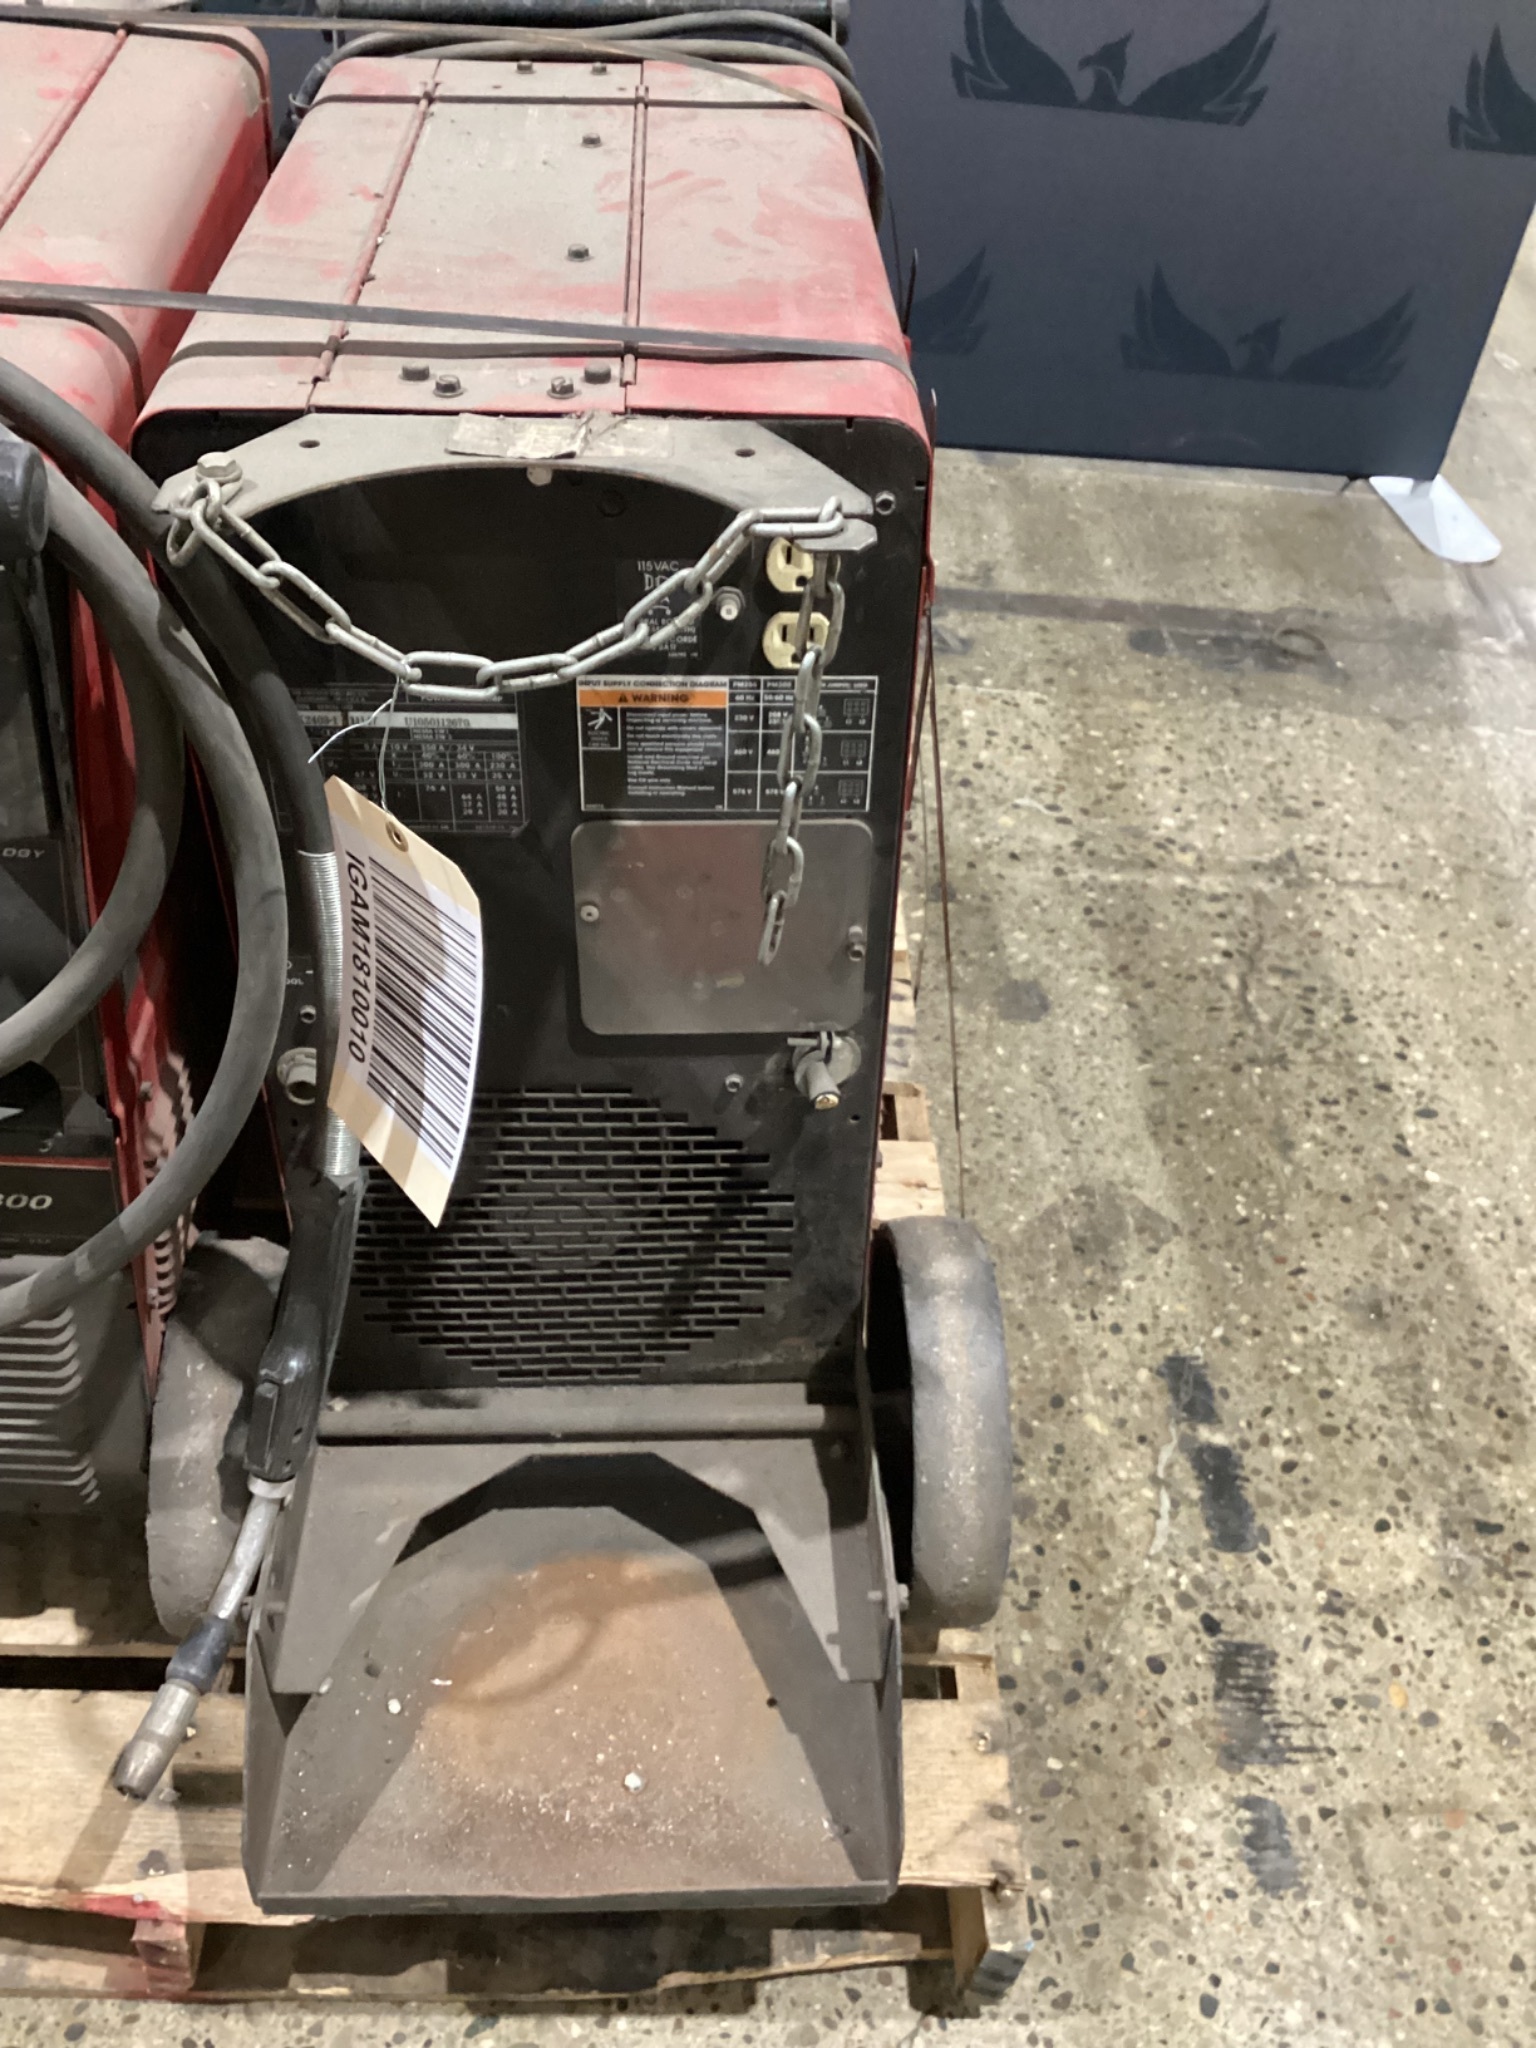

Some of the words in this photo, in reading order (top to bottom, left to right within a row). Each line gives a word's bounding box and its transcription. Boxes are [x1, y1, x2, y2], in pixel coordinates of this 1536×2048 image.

[637, 560, 680, 572] 115VAC
[631, 693, 690, 703] WARNING
[345, 848, 372, 1064] IGAM1810010
